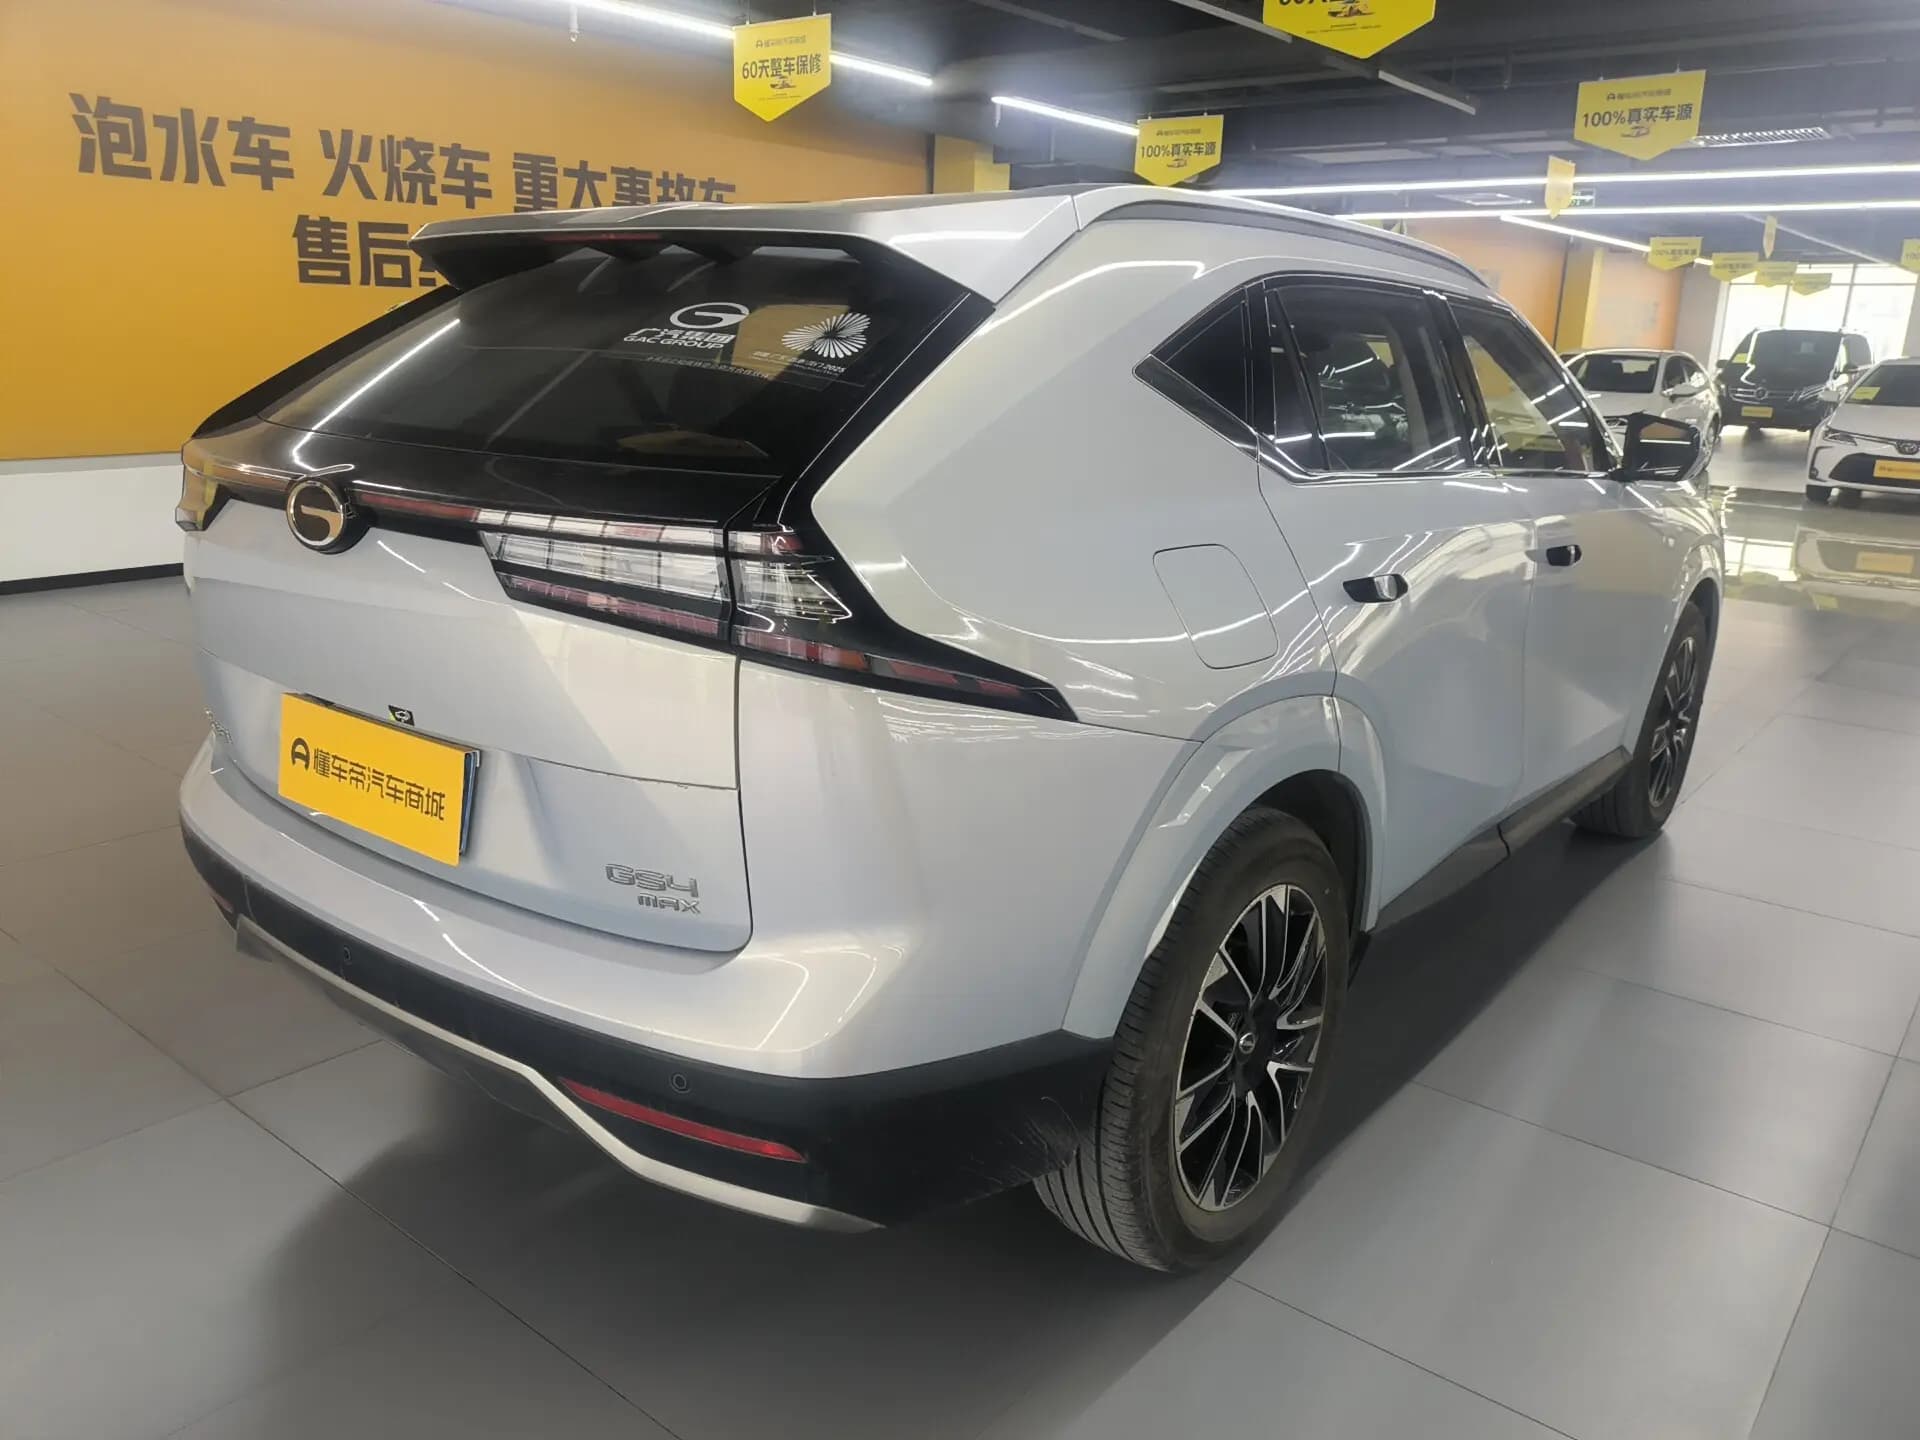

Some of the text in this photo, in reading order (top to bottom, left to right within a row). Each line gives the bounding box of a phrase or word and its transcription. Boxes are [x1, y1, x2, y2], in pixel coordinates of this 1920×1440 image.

[742, 53, 822, 80] 60天整车保修
[1582, 103, 1694, 129] 100%真实车源
[68, 92, 295, 192] 泡水车
[318, 128, 493, 210] 火烧车
[1140, 141, 1217, 159] 100%真实车源
[292, 213, 438, 289] 售后
[623, 335, 724, 350] GAC GROUP
[628, 327, 736, 344] 广汽集团
[313, 747, 447, 821] 懂车帝汽车商城
[605, 863, 699, 898] GS4
